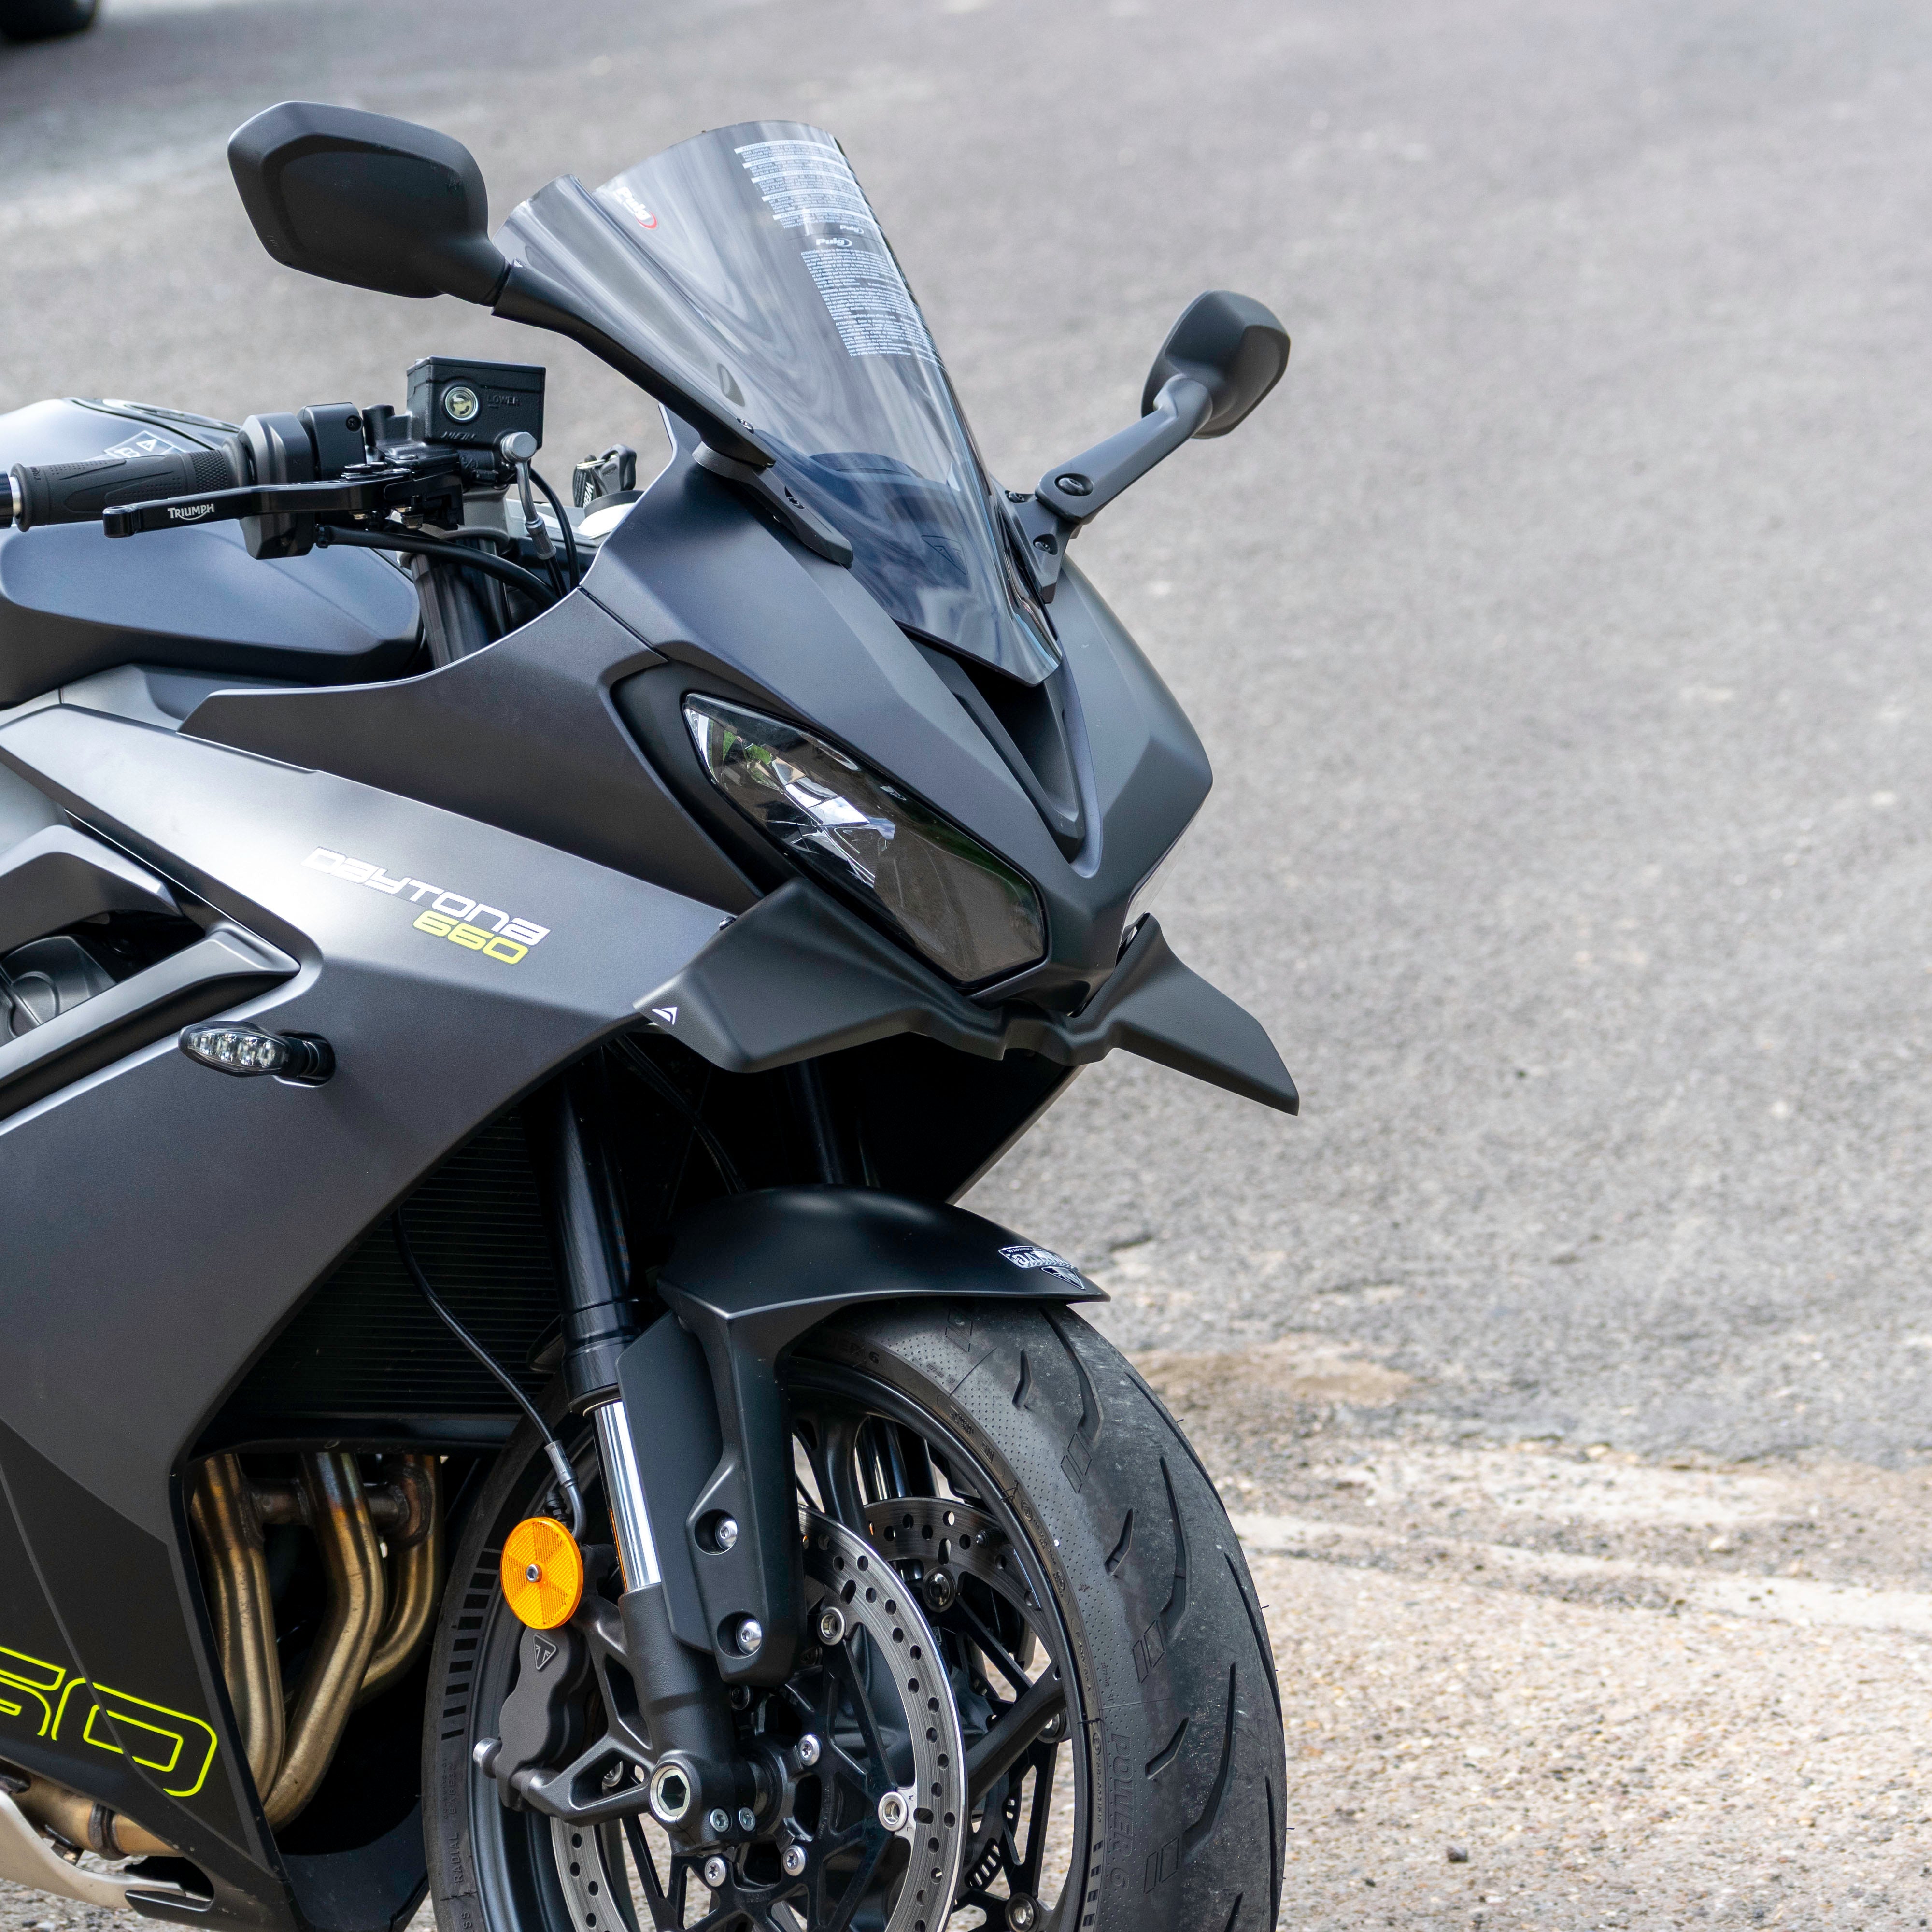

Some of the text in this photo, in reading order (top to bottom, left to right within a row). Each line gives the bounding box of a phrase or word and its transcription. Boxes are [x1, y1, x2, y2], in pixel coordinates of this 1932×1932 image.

[816, 237, 847, 247] Puig
[840, 225, 861, 233] Puig
[487, 394, 521, 405] LOWER
[167, 503, 214, 520] TRIUMPH
[300, 846, 552, 946] DAYTONA
[412, 910, 530, 965] 660
[1111, 1733, 1134, 1857] POWER
[449, 1832, 464, 1884] RADIAL
